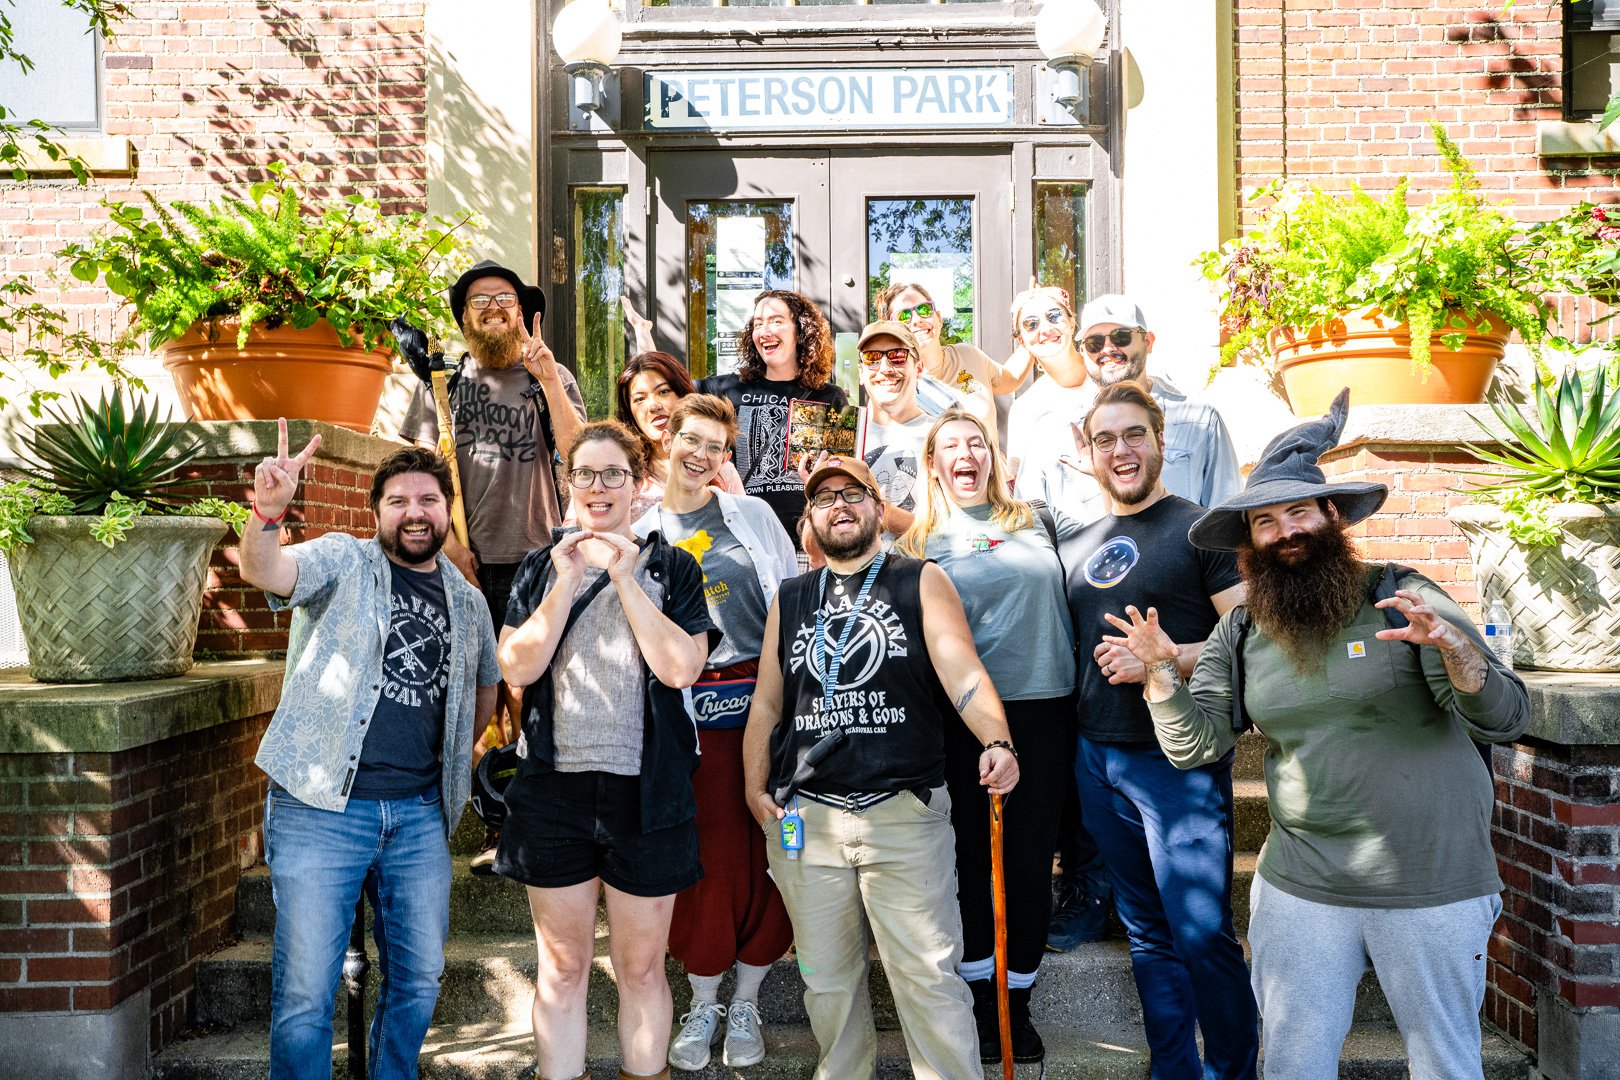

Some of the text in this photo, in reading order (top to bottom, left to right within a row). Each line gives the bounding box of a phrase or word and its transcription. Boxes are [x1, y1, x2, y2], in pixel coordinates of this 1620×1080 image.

[660, 74, 1001, 119] PETERSON PARK
[741, 393, 798, 405] CHICA
[746, 484, 806, 495] OWN PLEASURE
[704, 581, 729, 597] atch
[391, 593, 451, 644] ELVERS
[789, 622, 816, 674] VOX
[380, 674, 422, 708] OCAL
[812, 690, 886, 714] SLAYERS OF
[795, 706, 906, 731] DRAGONS & GODS
